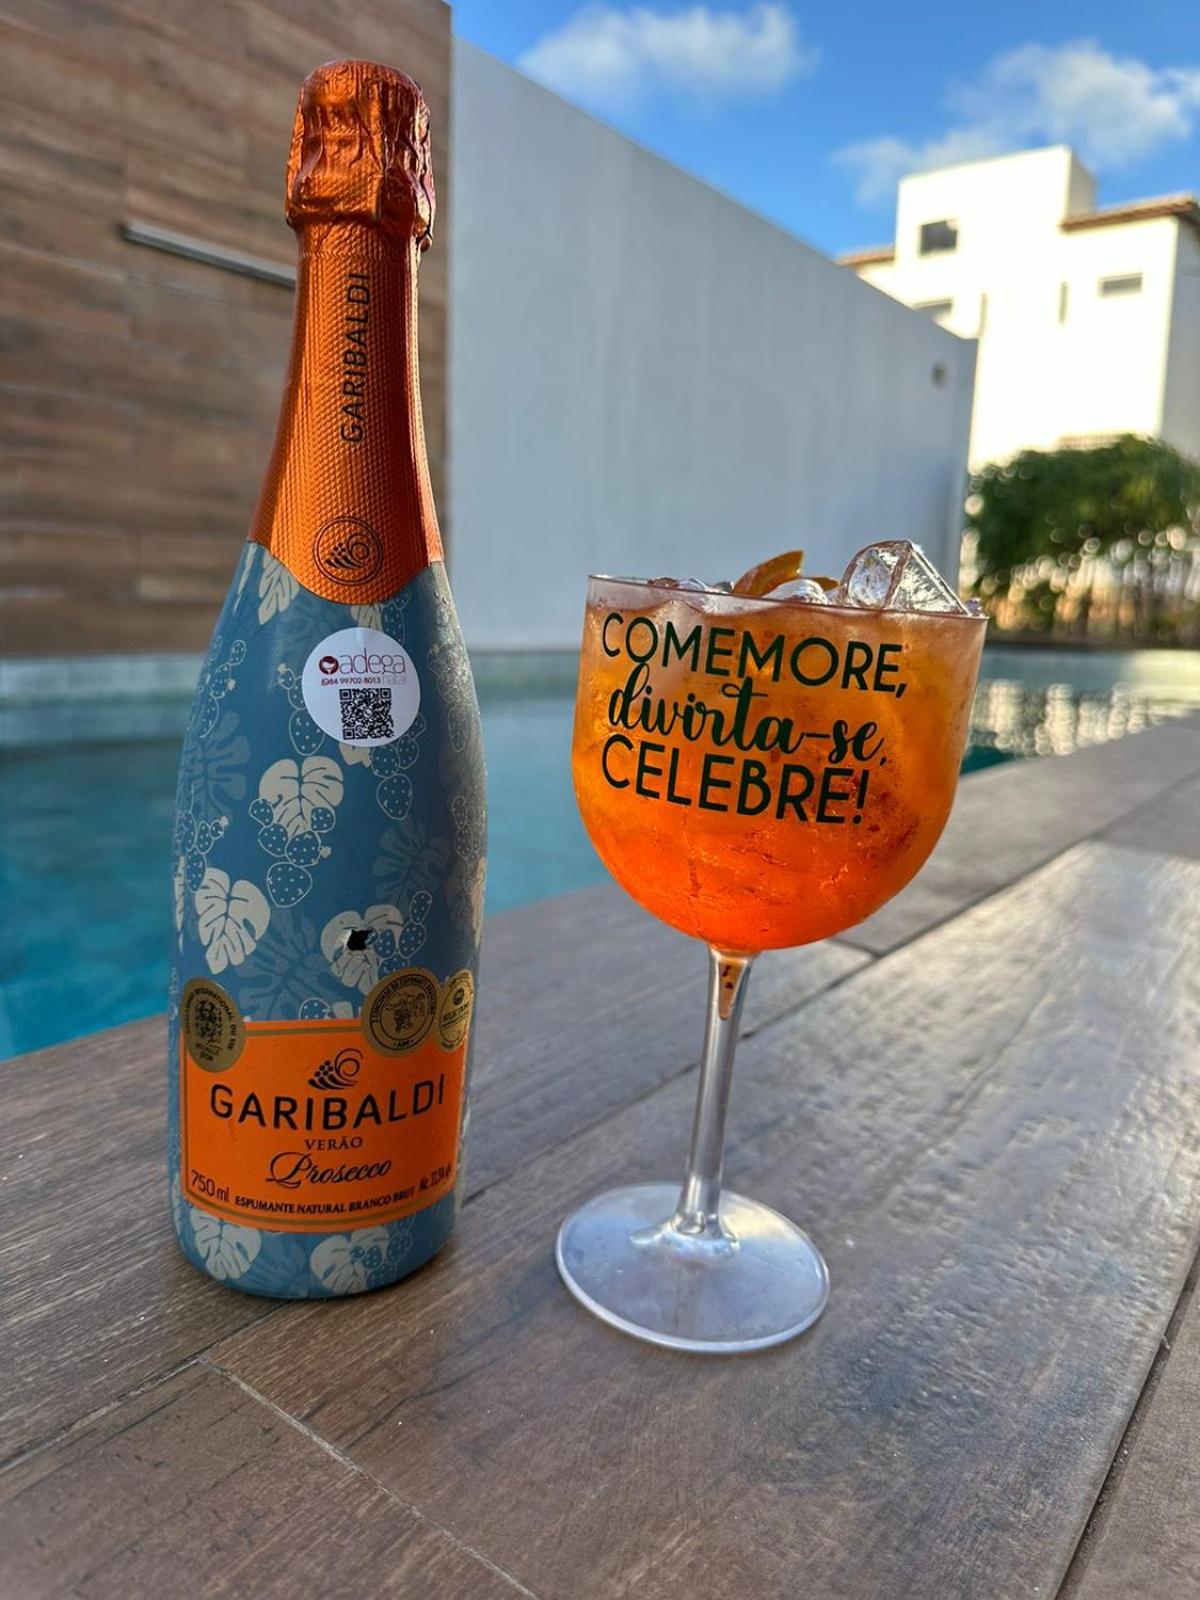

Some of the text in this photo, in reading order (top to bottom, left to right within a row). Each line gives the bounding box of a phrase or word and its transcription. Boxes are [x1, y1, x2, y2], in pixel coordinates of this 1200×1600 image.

[340, 273, 370, 443] GARIBALDI
[339, 647, 406, 675] adega
[602, 612, 907, 698] COMEMORE,
[602, 733, 869, 825] CELEBRE!
[210, 1073, 445, 1131] GARIBALDI
[304, 1135, 364, 1151] VERÃO
[265, 1151, 392, 1189] Prosecco
[234, 1195, 295, 1214] ESPUMANTE
[297, 1202, 346, 1214] NATURAL
[349, 1194, 392, 1212] BRANCO
